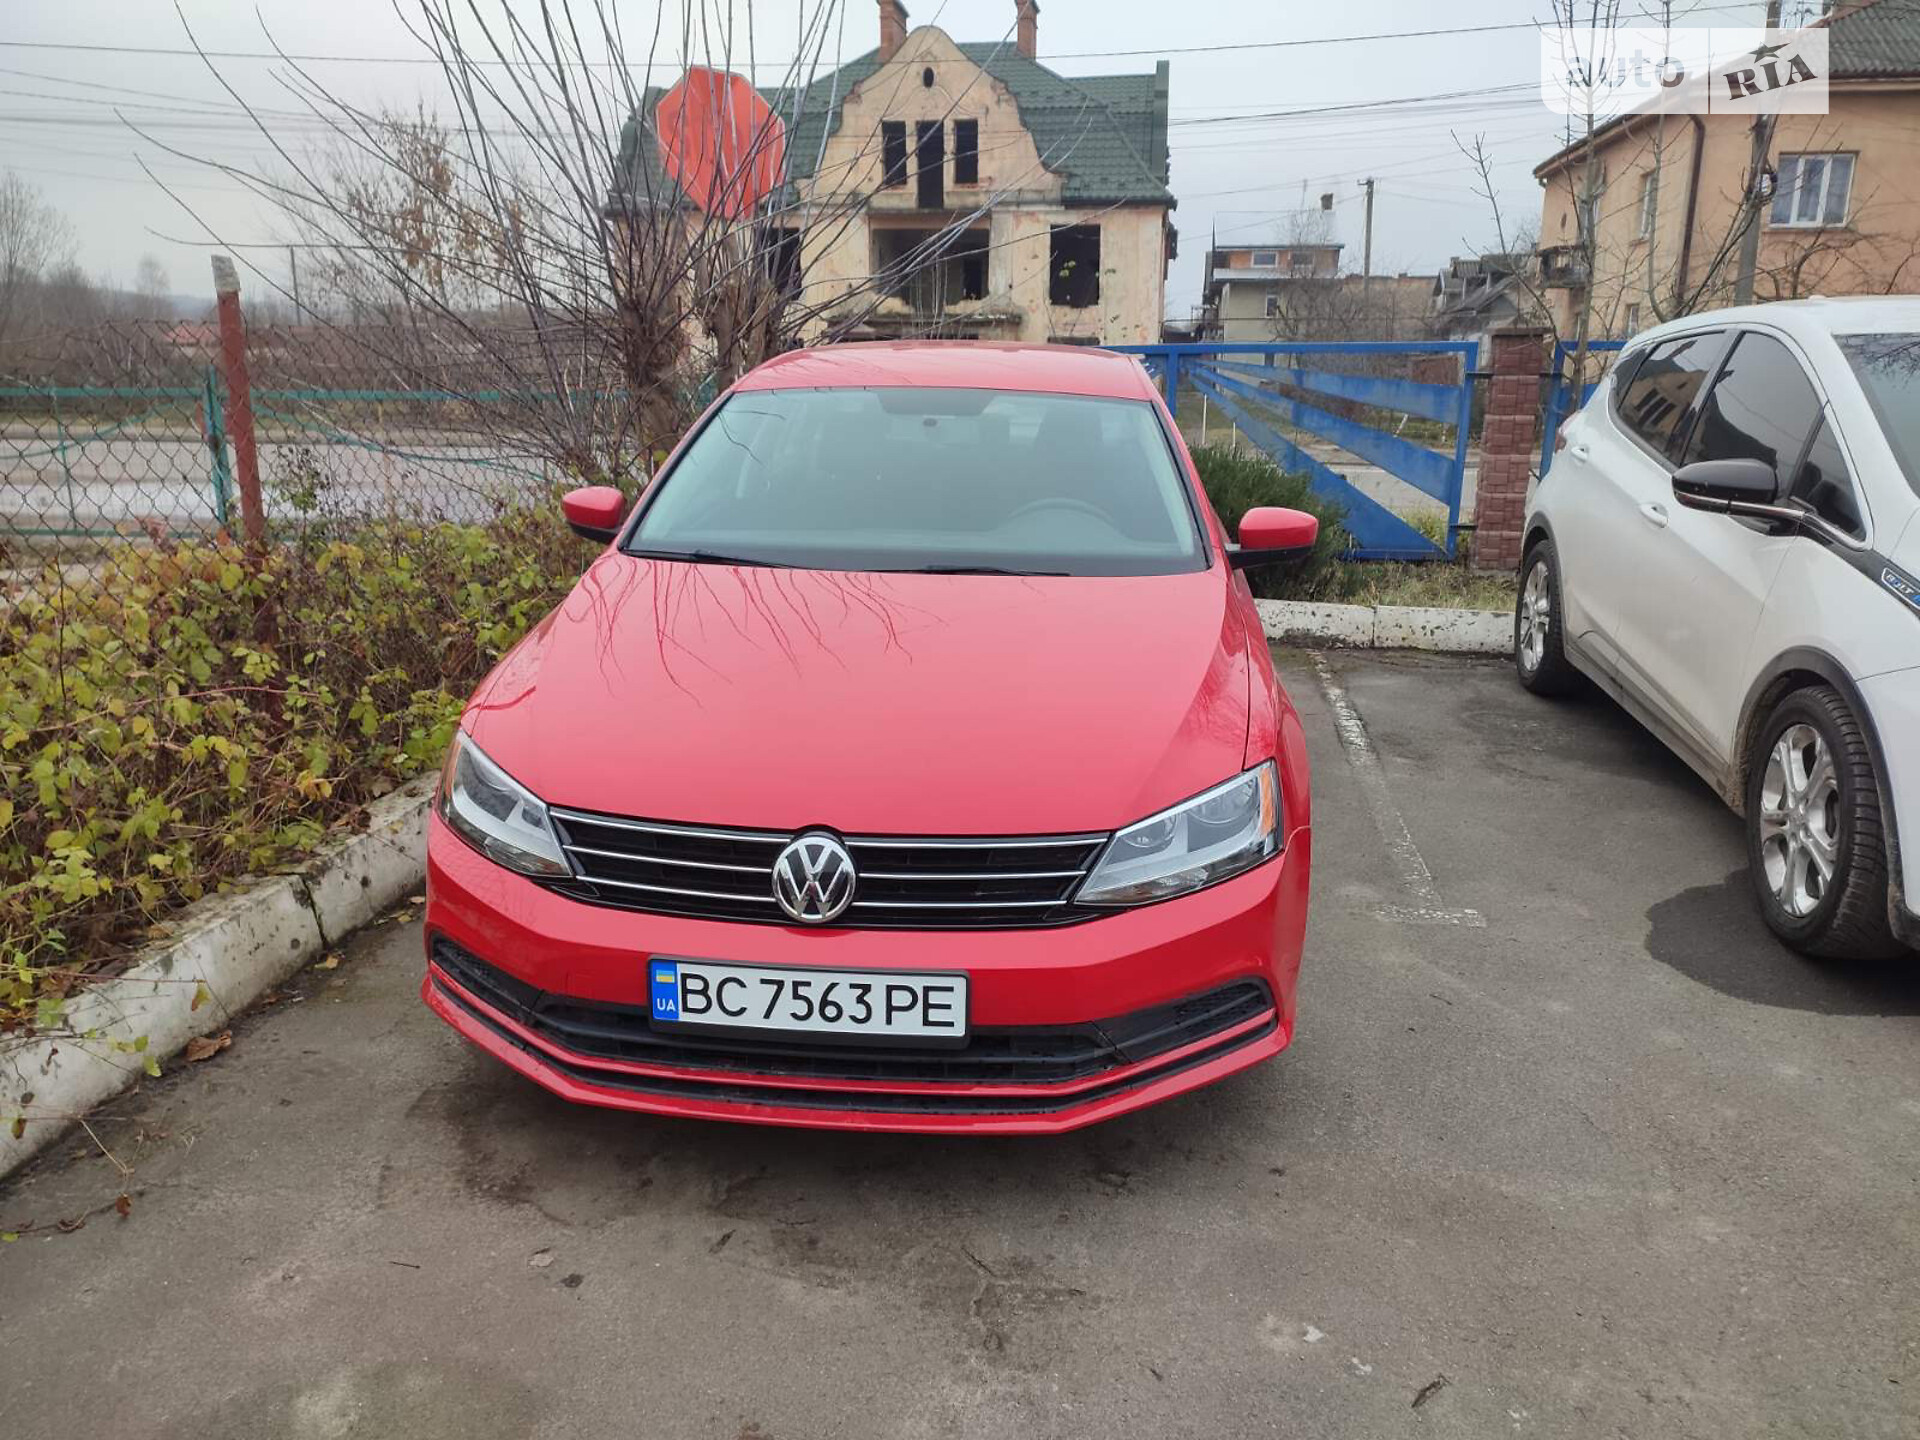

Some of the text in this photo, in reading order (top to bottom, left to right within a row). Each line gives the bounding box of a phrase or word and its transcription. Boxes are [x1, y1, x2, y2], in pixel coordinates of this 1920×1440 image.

[656, 998, 676, 1013] UA
[680, 972, 955, 1027] BC 7563 PE
